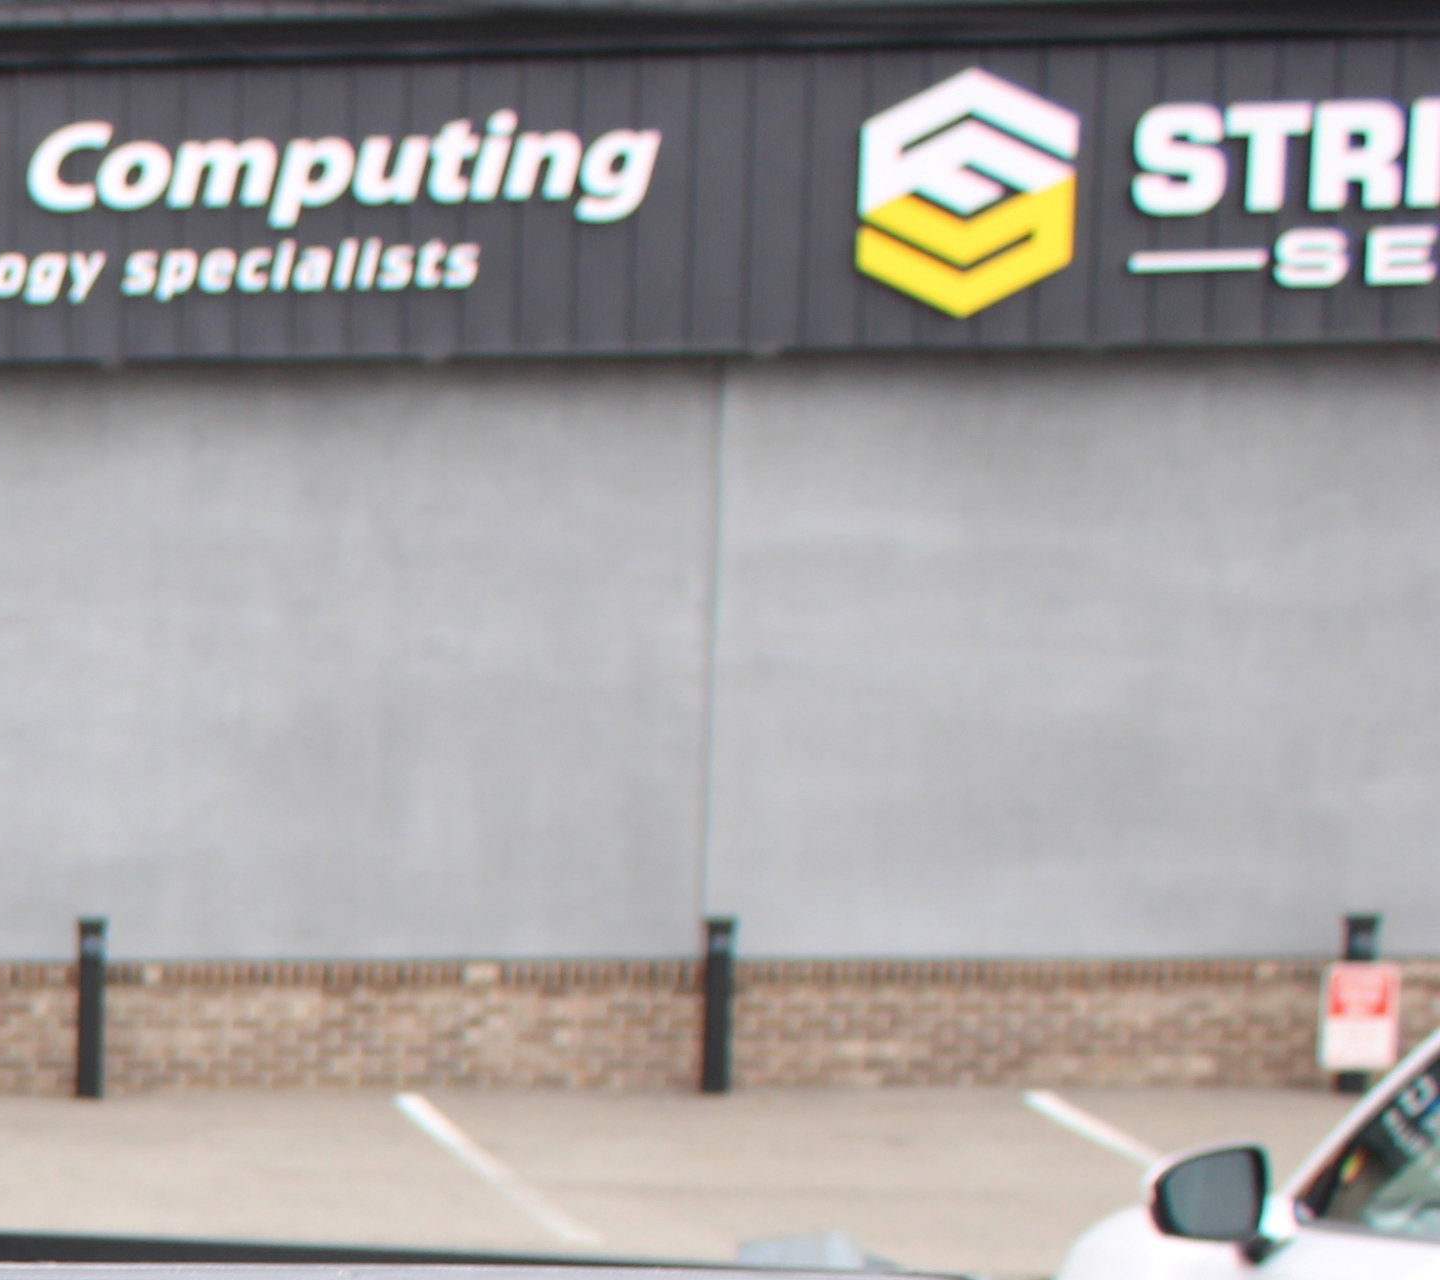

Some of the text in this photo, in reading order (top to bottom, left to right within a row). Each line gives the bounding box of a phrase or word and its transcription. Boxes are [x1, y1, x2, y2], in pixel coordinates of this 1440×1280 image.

[26, 108, 663, 228] Computing
[122, 236, 481, 299] specialists
[1272, 223, 1438, 290] SE
